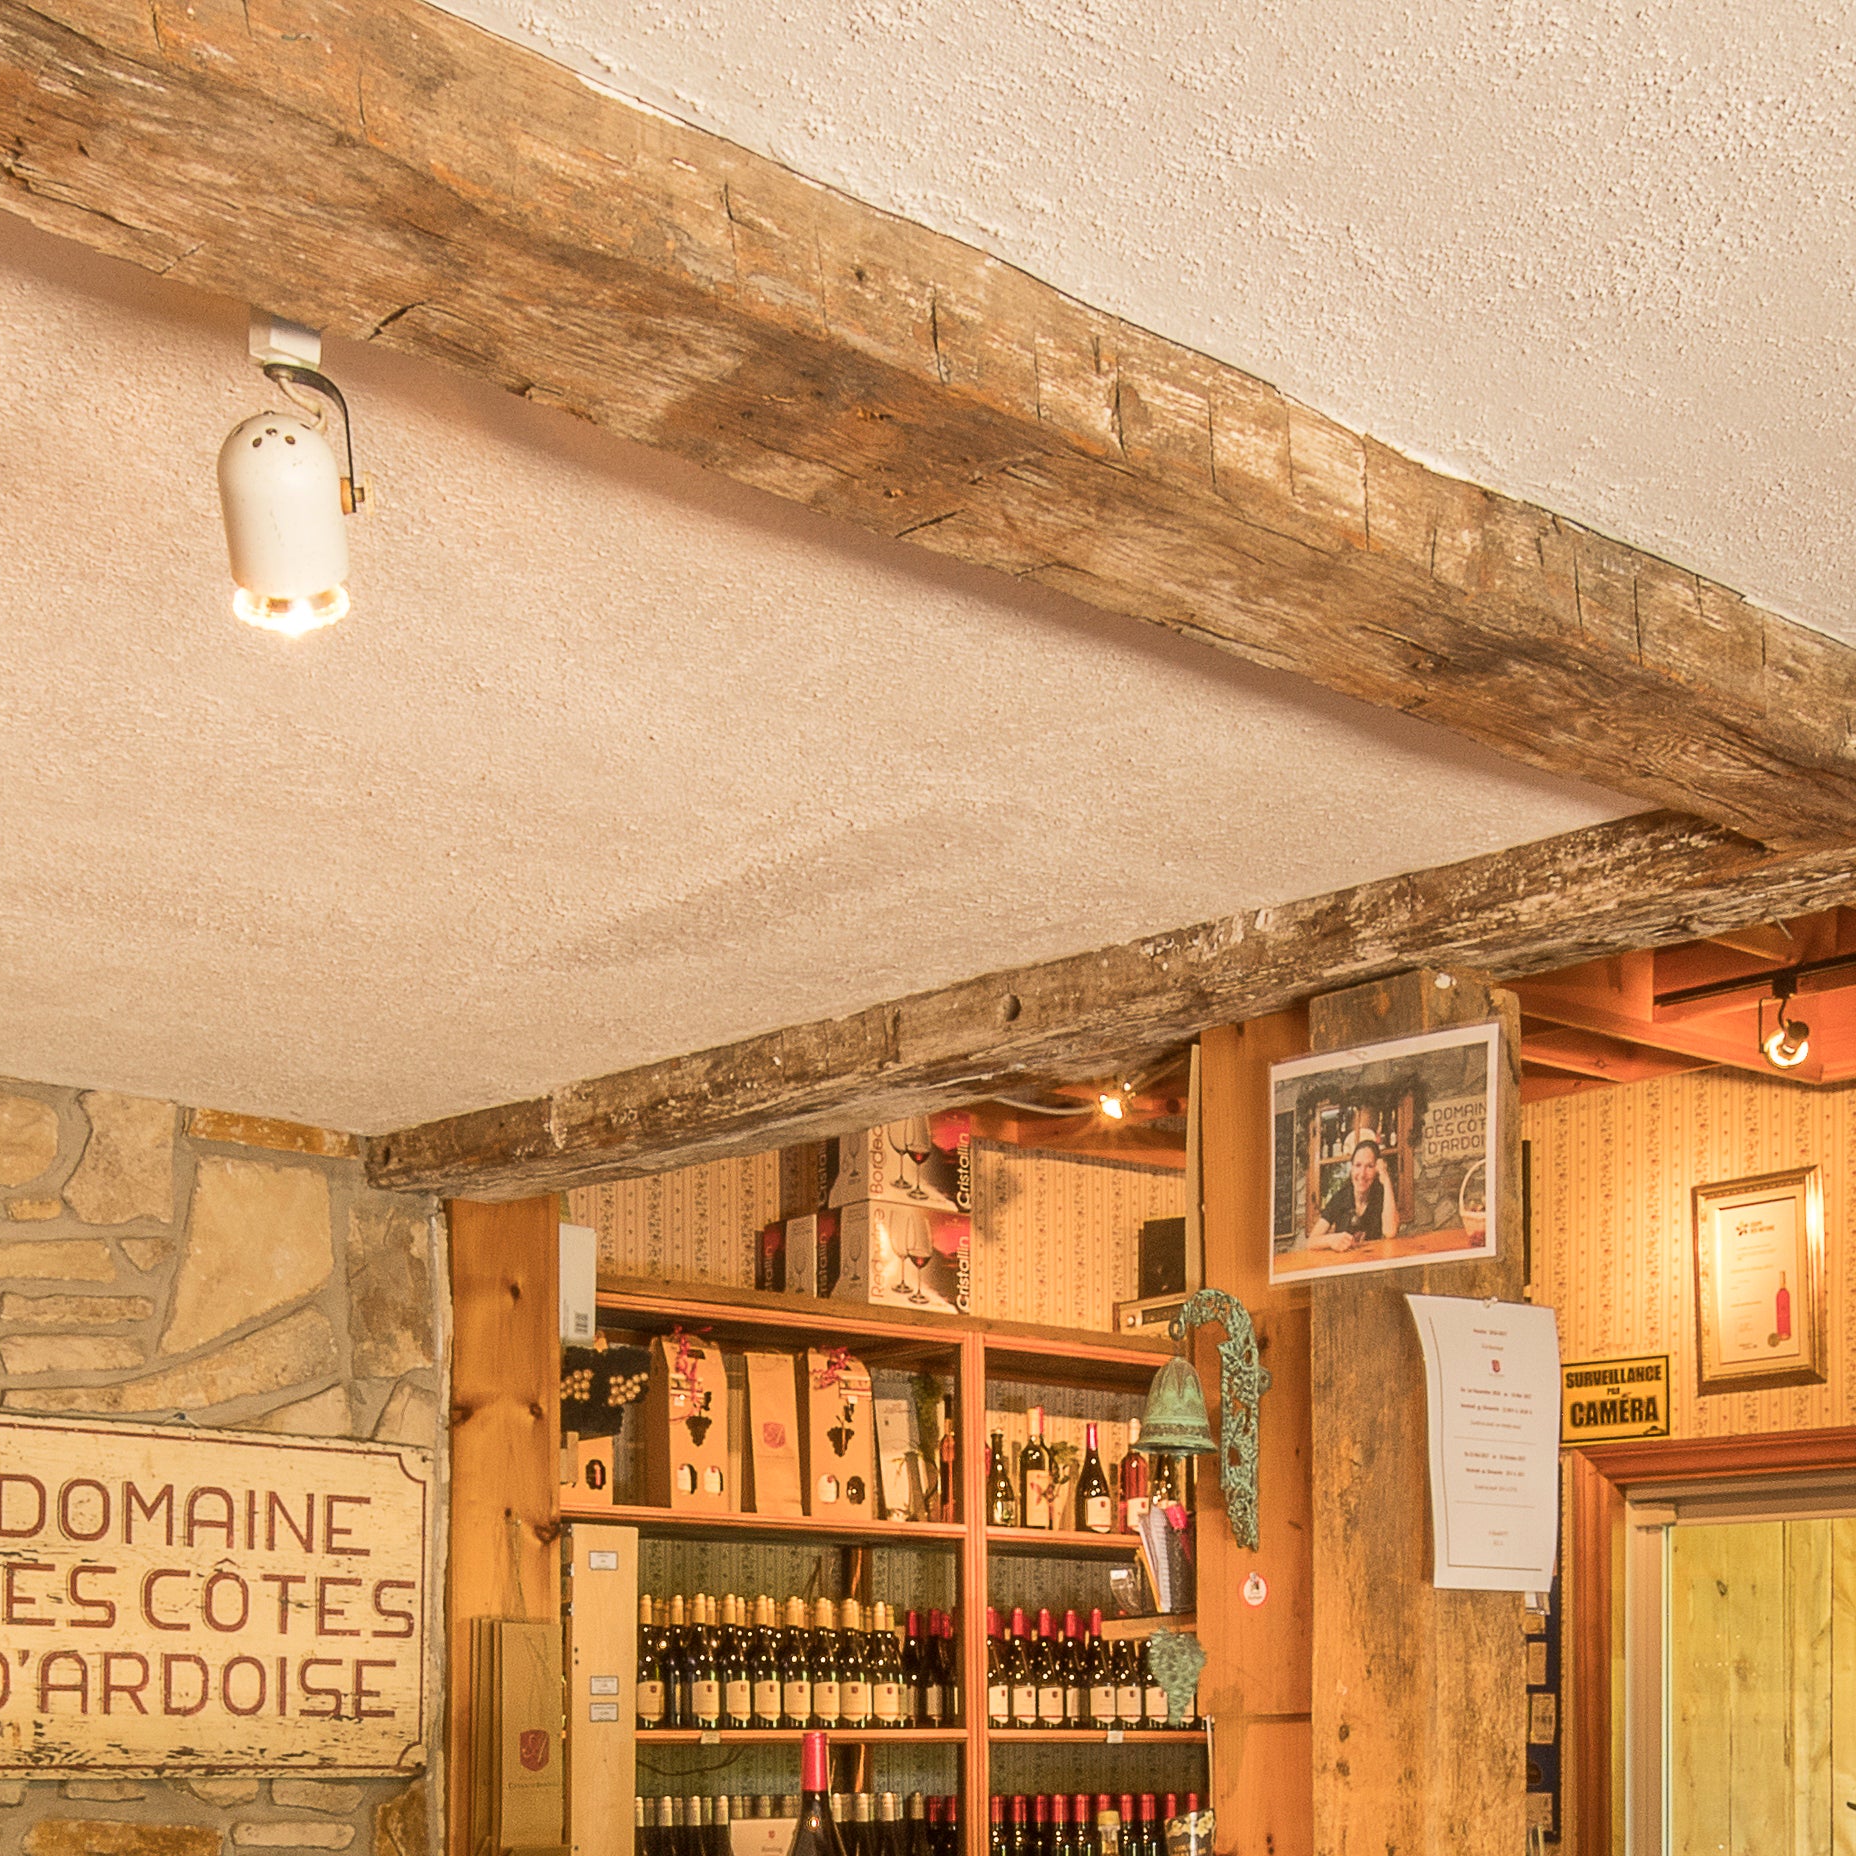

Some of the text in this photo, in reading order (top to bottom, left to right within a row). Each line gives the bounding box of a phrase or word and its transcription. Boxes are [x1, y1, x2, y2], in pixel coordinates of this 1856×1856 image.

[1433, 1102, 1486, 1121] DOMAIN
[1429, 1135, 1485, 1154] D'ARDOI
[957, 1133, 971, 1211] Cristallin
[957, 1236, 971, 1314] Cristallin
[1566, 1365, 1662, 1389] SURVEILLANCE
[1570, 1392, 1659, 1428] CAMÉRA
[141, 1557, 416, 1638] CÔTES
